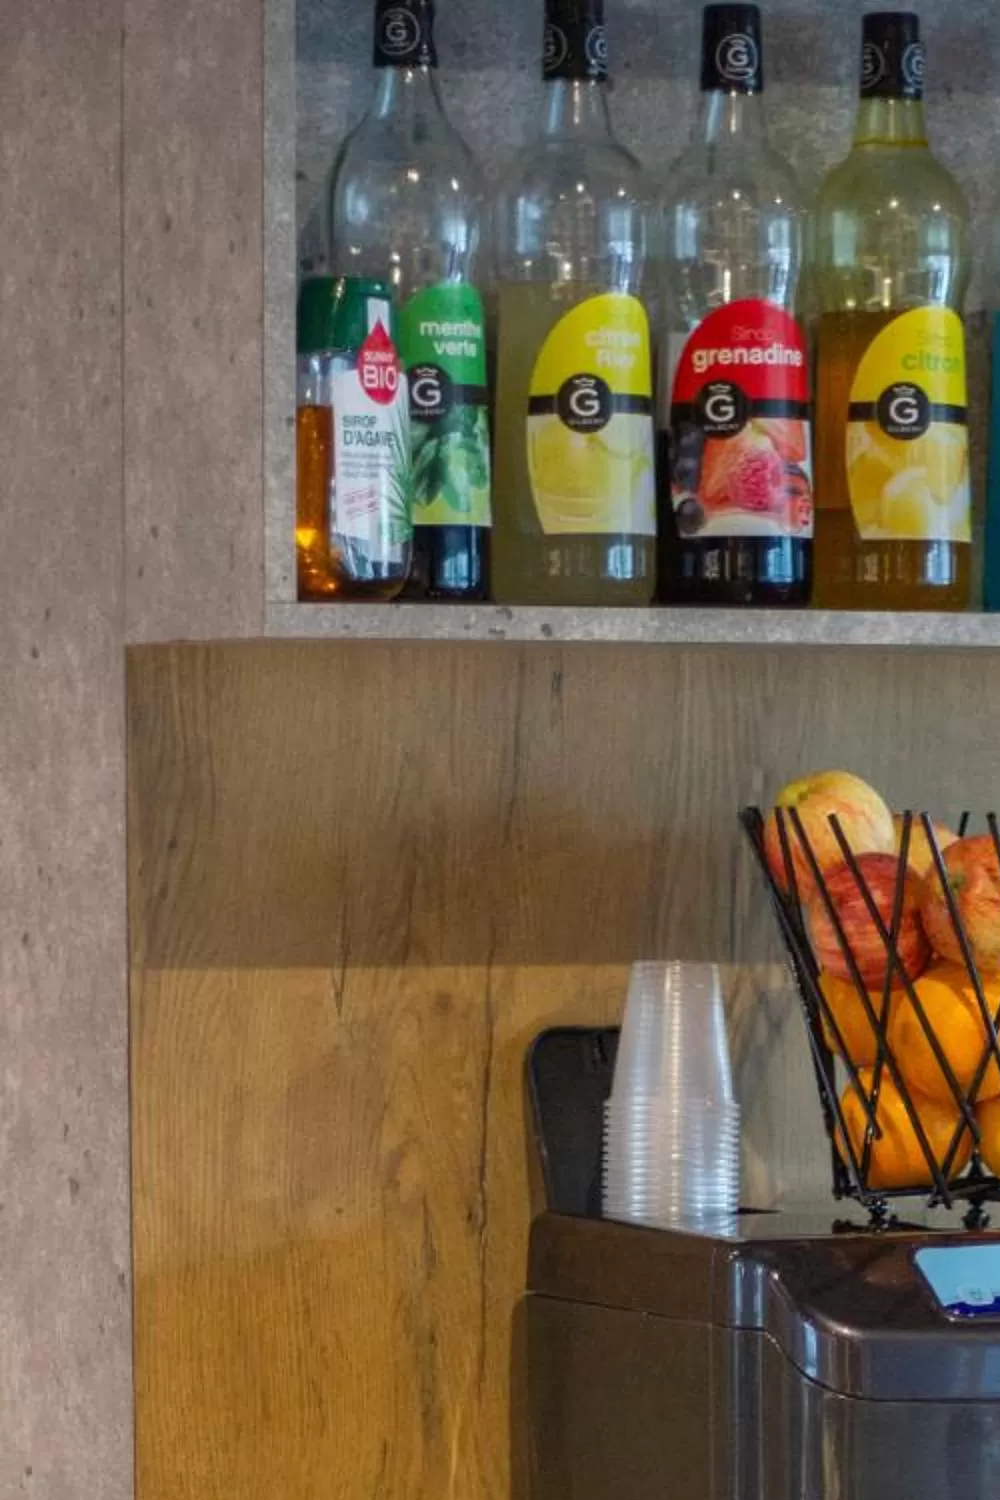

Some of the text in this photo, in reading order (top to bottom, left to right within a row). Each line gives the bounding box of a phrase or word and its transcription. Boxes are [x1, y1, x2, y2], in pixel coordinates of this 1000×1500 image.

[691, 342, 803, 373] grenadine
[363, 364, 397, 389] BIO
[411, 378, 442, 407] G
[569, 388, 601, 417] G
[705, 394, 735, 423] G
[889, 397, 919, 425] G
